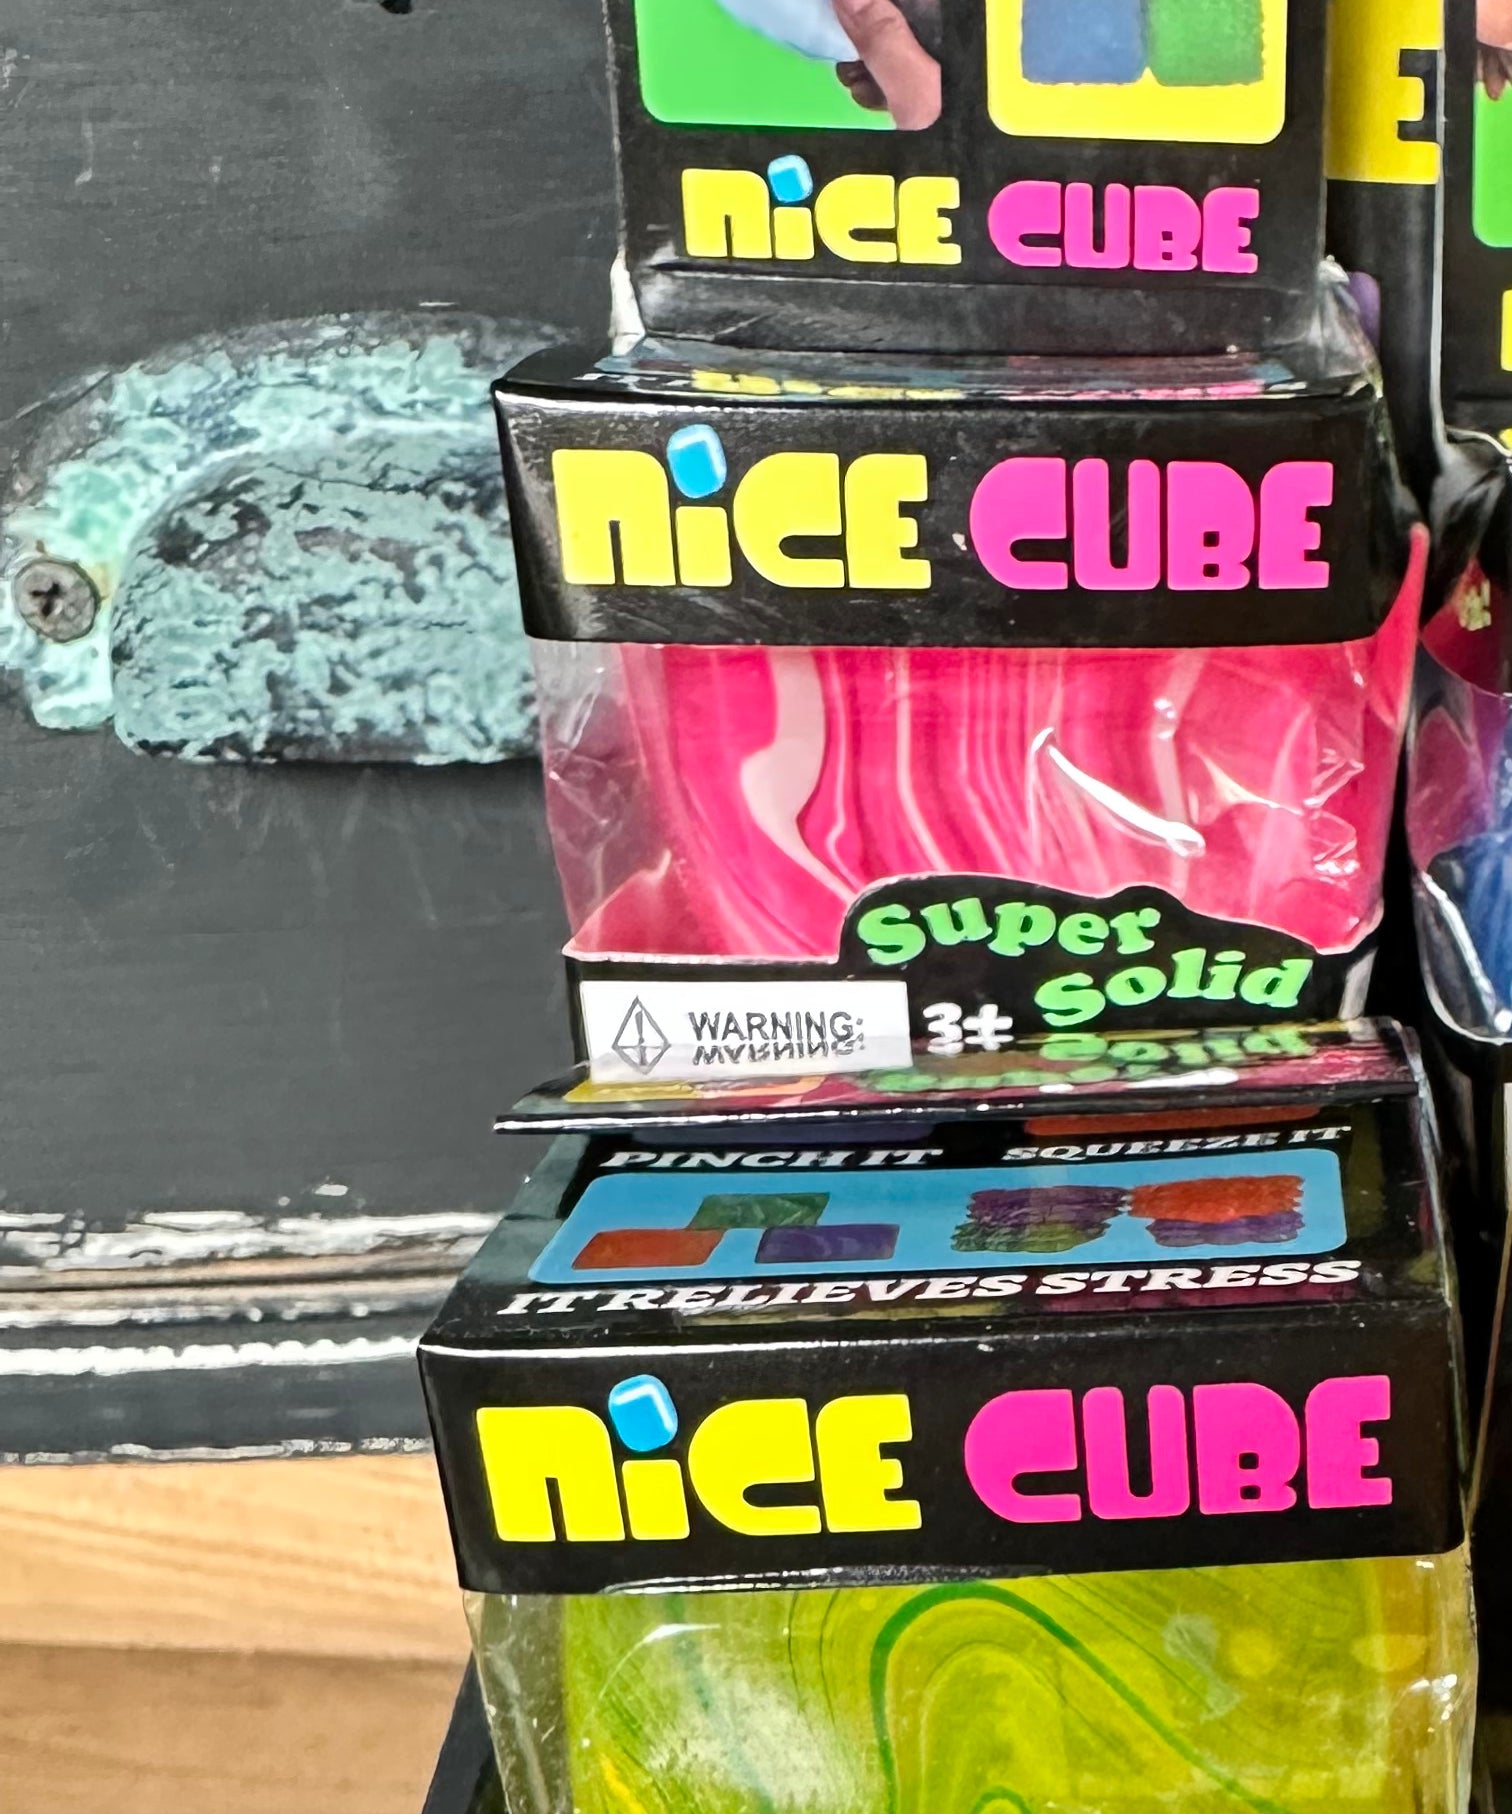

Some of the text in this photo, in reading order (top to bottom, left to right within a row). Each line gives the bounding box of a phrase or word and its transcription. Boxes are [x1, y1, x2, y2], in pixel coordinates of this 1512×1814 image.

[987, 180, 1260, 274] CUBE
[969, 457, 1334, 591] CUBE
[857, 896, 1162, 967] Super
[1033, 947, 1315, 1028] Solid
[688, 1010, 865, 1042] WARNING:
[600, 1148, 944, 1167] PINCH IT
[1000, 1125, 1352, 1160] SQUEEZE IT
[496, 1259, 1363, 1315] IT RELIEVES STRESS
[964, 1375, 1393, 1524] CUBE
